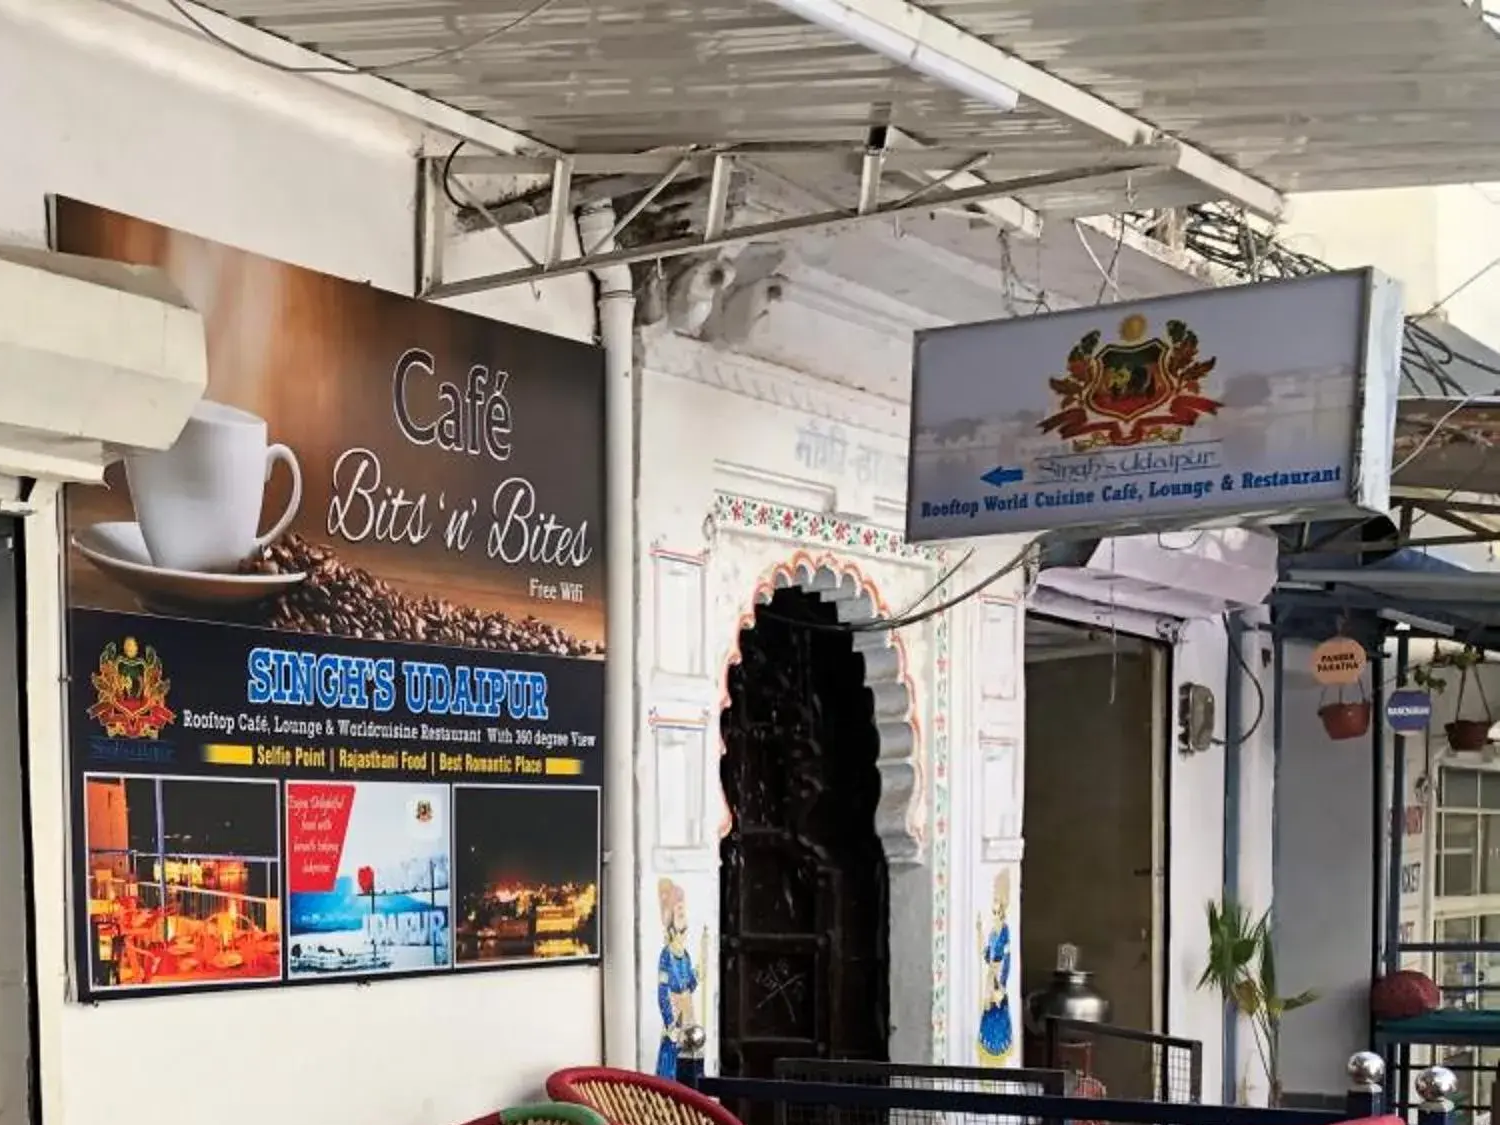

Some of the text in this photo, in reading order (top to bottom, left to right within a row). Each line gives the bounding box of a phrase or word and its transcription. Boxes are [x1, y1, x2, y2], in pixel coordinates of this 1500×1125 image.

[393, 347, 512, 461] Café
[326, 448, 432, 544] Bits
[487, 477, 592, 567] Bites
[921, 465, 1341, 518] Rooftop World Cuisine Café, Lounge & Restaurant
[529, 577, 557, 600] Free
[247, 647, 549, 720] SINGH'S UDAIPUR
[183, 709, 235, 735] Rooftop
[238, 713, 270, 735] Café,
[274, 715, 323, 738] Lounge
[325, 719, 335, 736] &
[421, 724, 481, 743] Restaurant
[487, 727, 513, 745] With
[515, 728, 533, 746] 360
[534, 729, 568, 749] degree
[570, 731, 596, 748] View
[257, 744, 542, 774] Selfie Point Rajasthani Food Best Romantic Place
